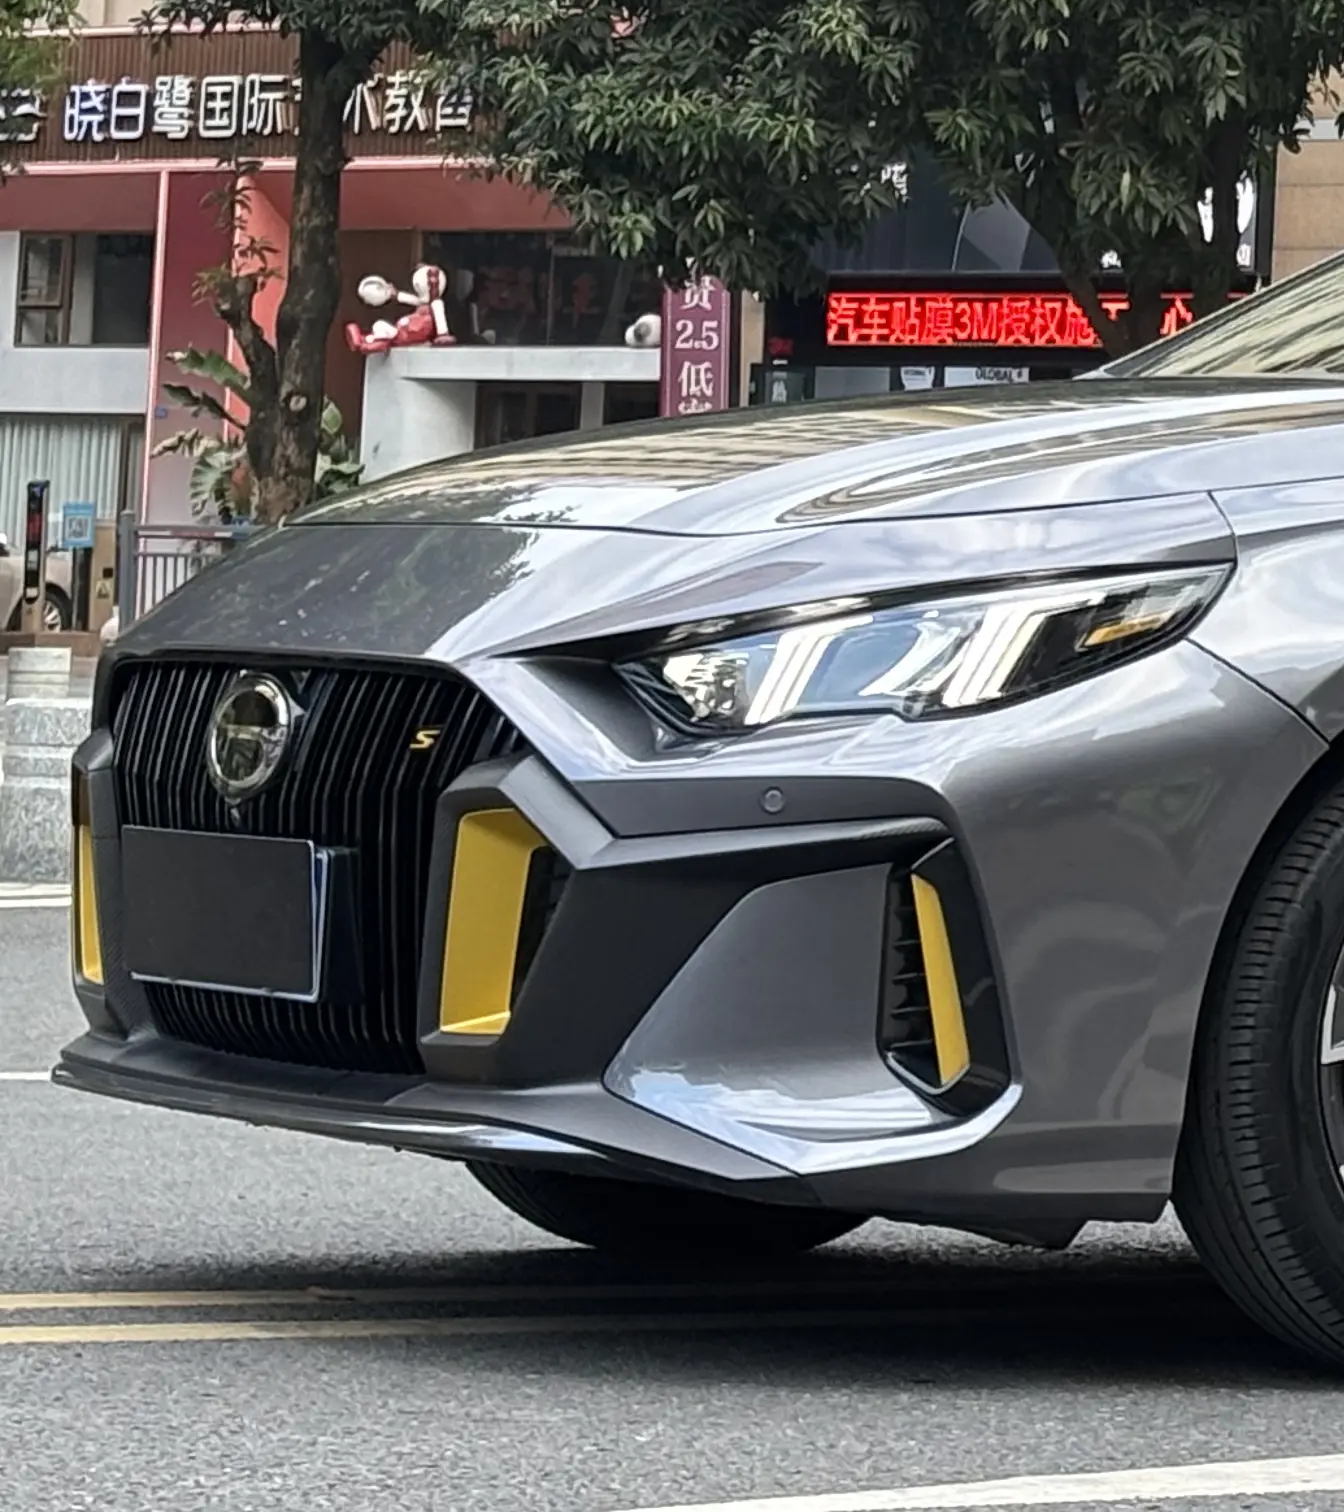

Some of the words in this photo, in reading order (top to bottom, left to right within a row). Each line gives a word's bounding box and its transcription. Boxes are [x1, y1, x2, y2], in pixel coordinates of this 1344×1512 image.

[63, 69, 473, 142] 晓白鹭国际术教育
